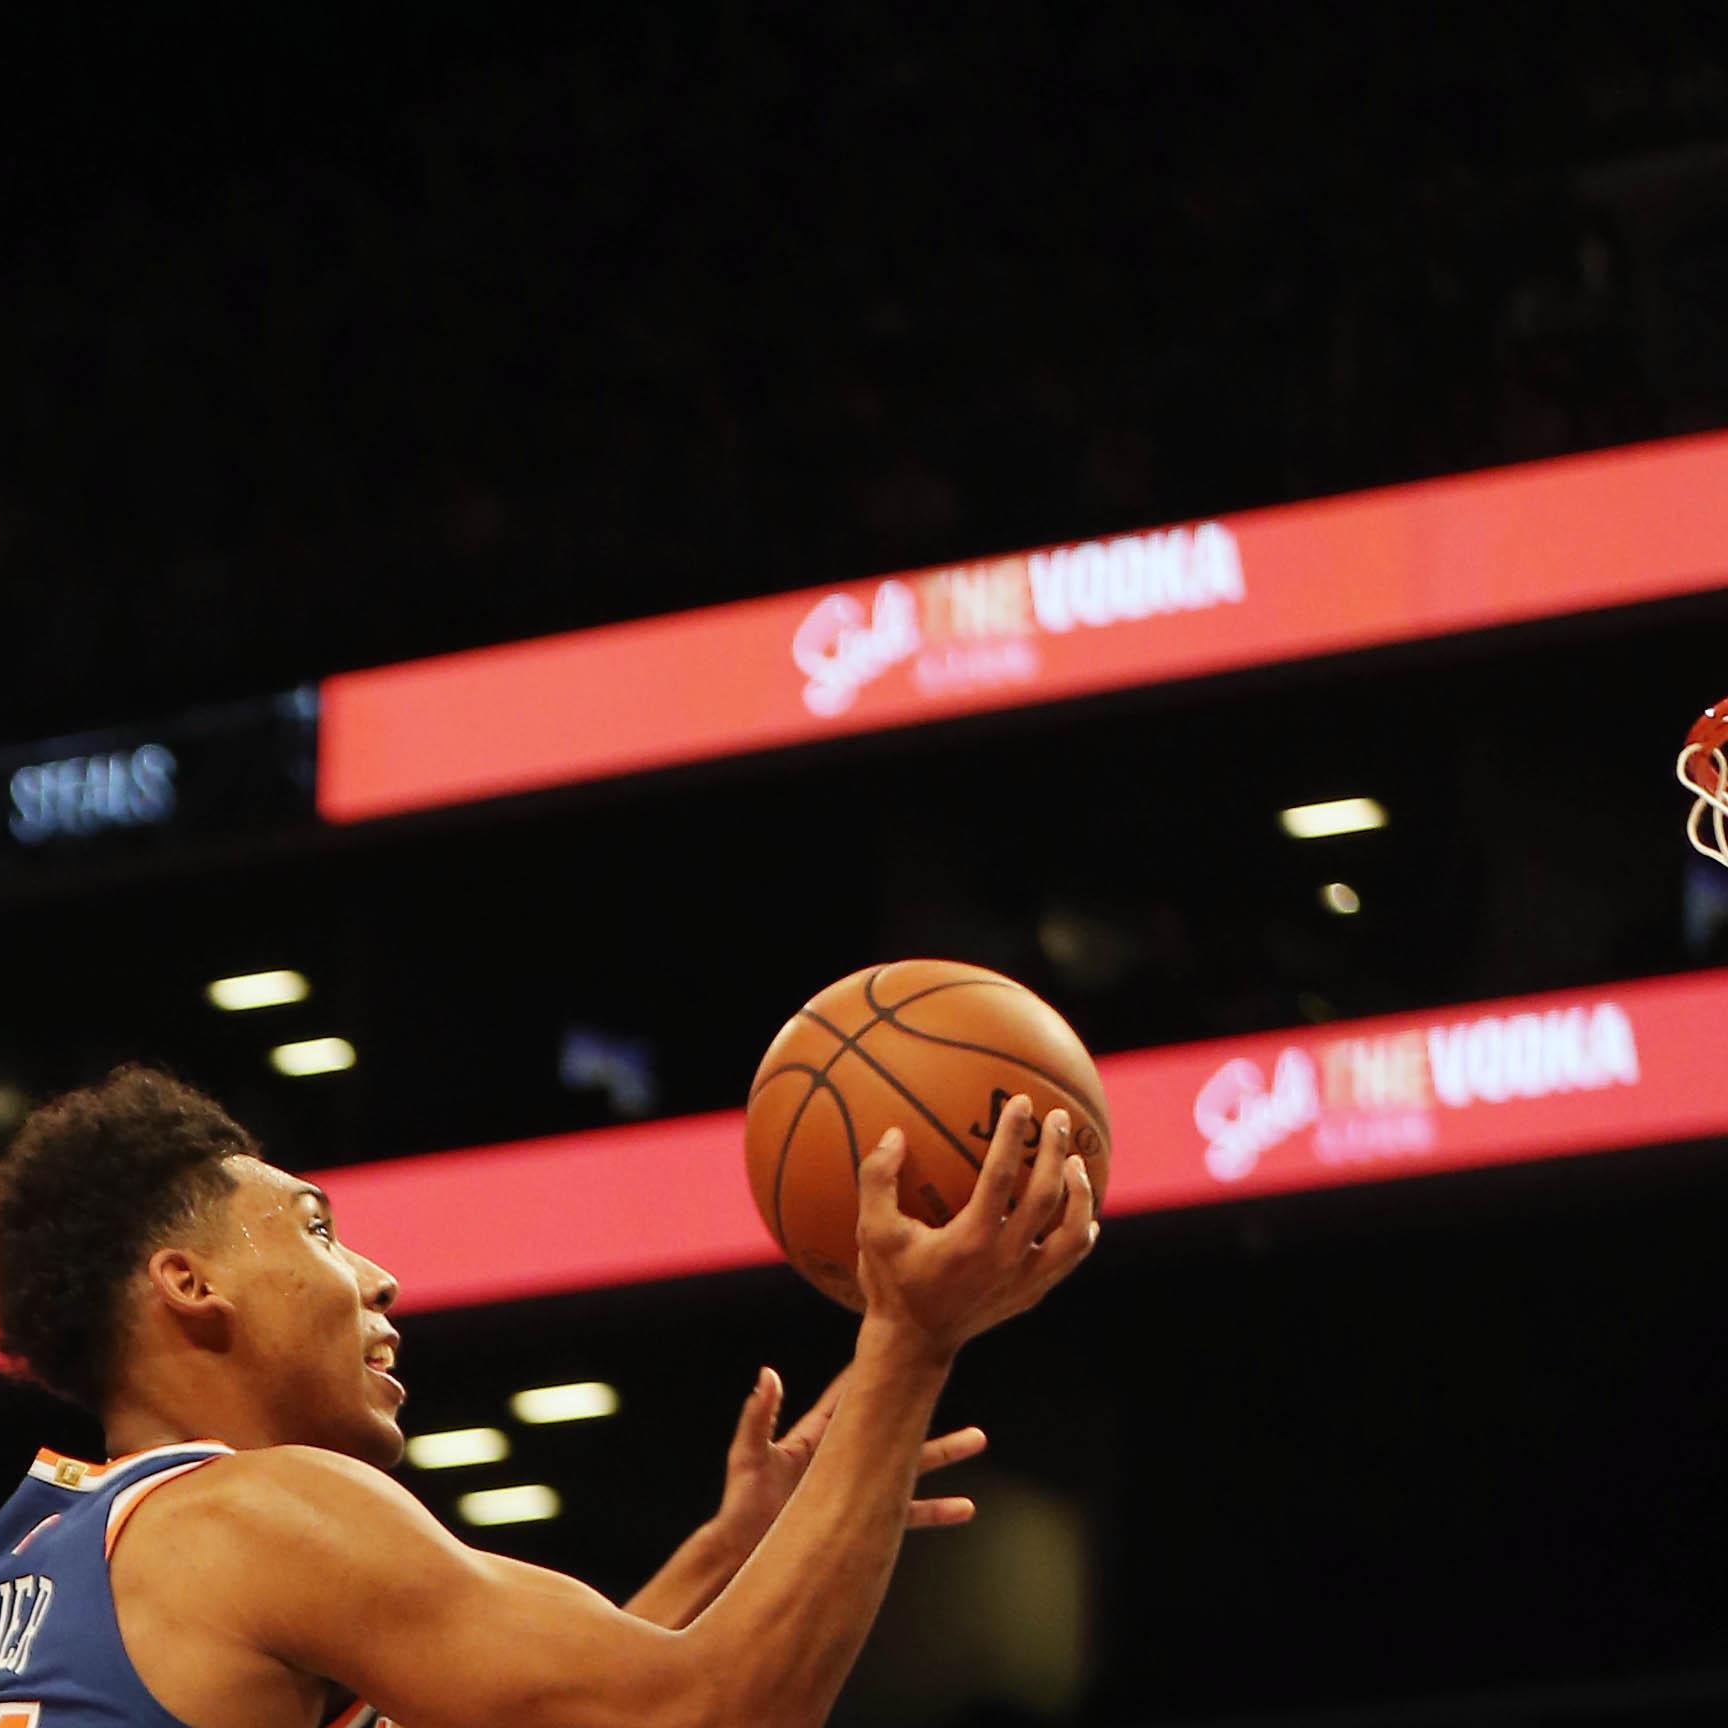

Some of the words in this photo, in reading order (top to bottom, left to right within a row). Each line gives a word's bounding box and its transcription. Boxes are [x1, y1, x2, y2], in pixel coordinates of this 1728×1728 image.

[1029, 521, 1245, 633] VODKA
[9, 744, 176, 842] STEALS
[1428, 1002, 1640, 1107] VODKA
